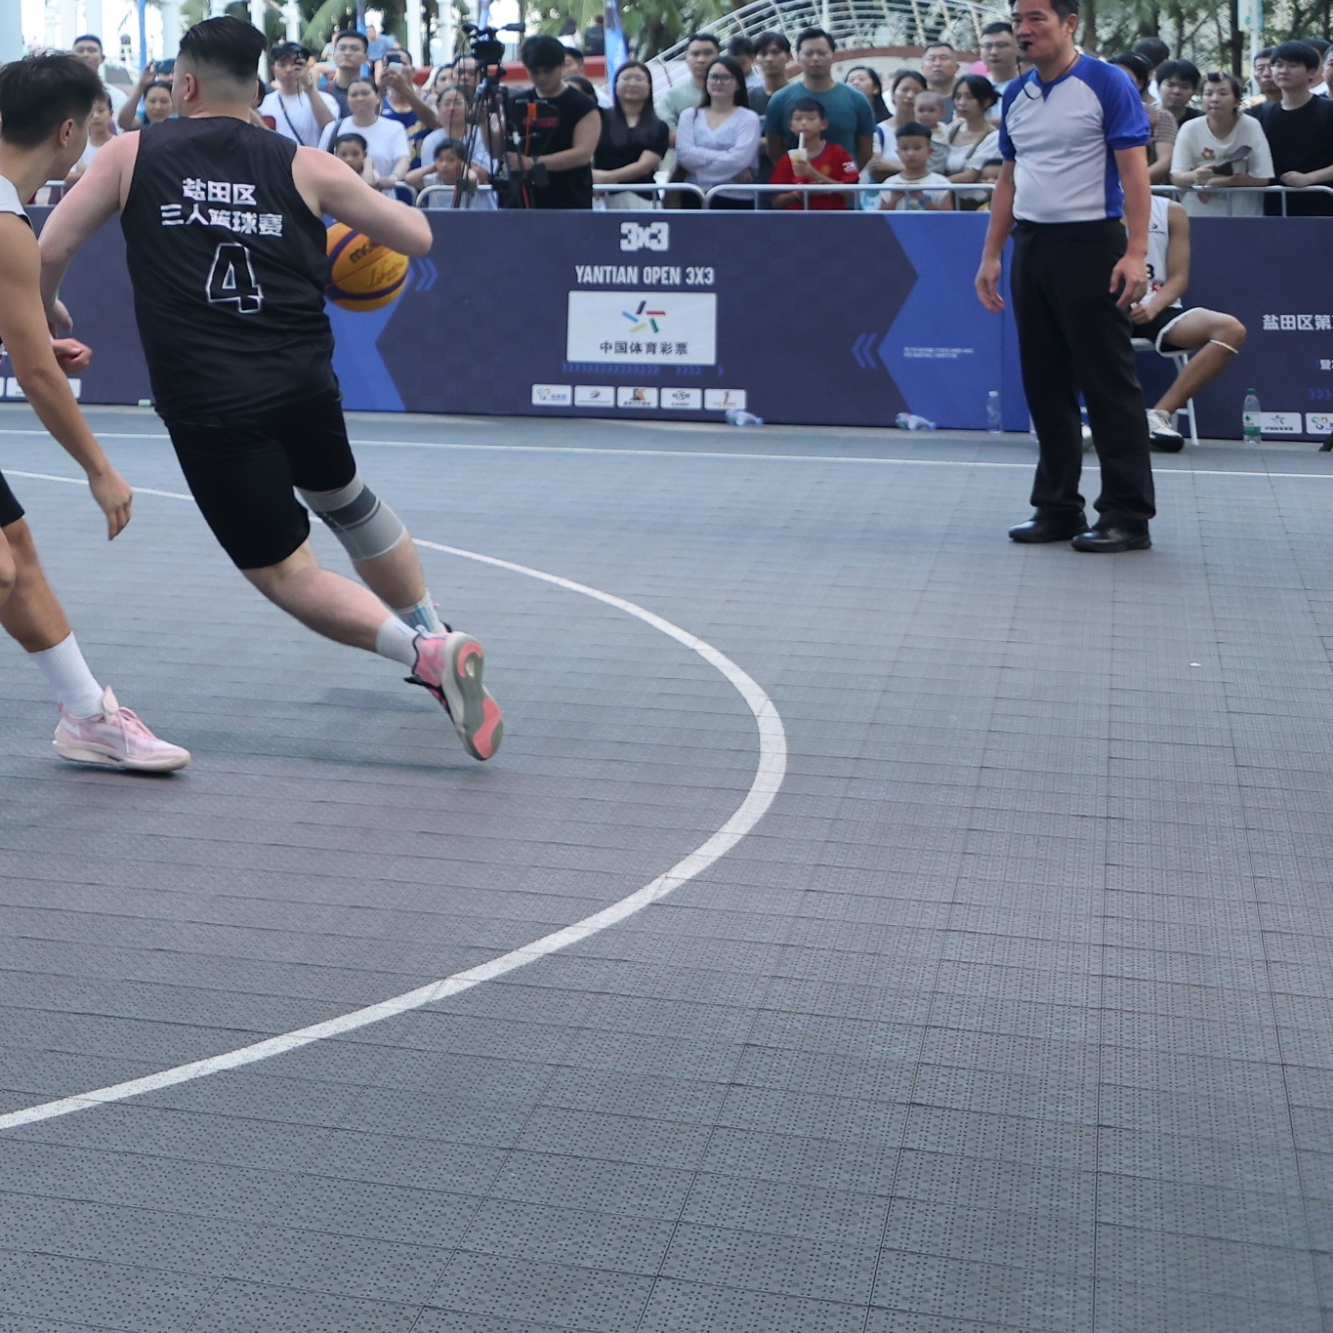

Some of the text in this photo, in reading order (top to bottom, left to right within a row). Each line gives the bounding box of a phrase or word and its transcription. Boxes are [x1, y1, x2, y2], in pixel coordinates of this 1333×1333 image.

[182, 178, 257, 206] 盐田区
[160, 203, 282, 237] 三人篮球赛
[205, 242, 264, 314] 4
[575, 266, 714, 284] YANTIAN OPEN 3X3
[1262, 314, 1333, 331] 盐田区第
[599, 340, 688, 355] 中国体育彩票
